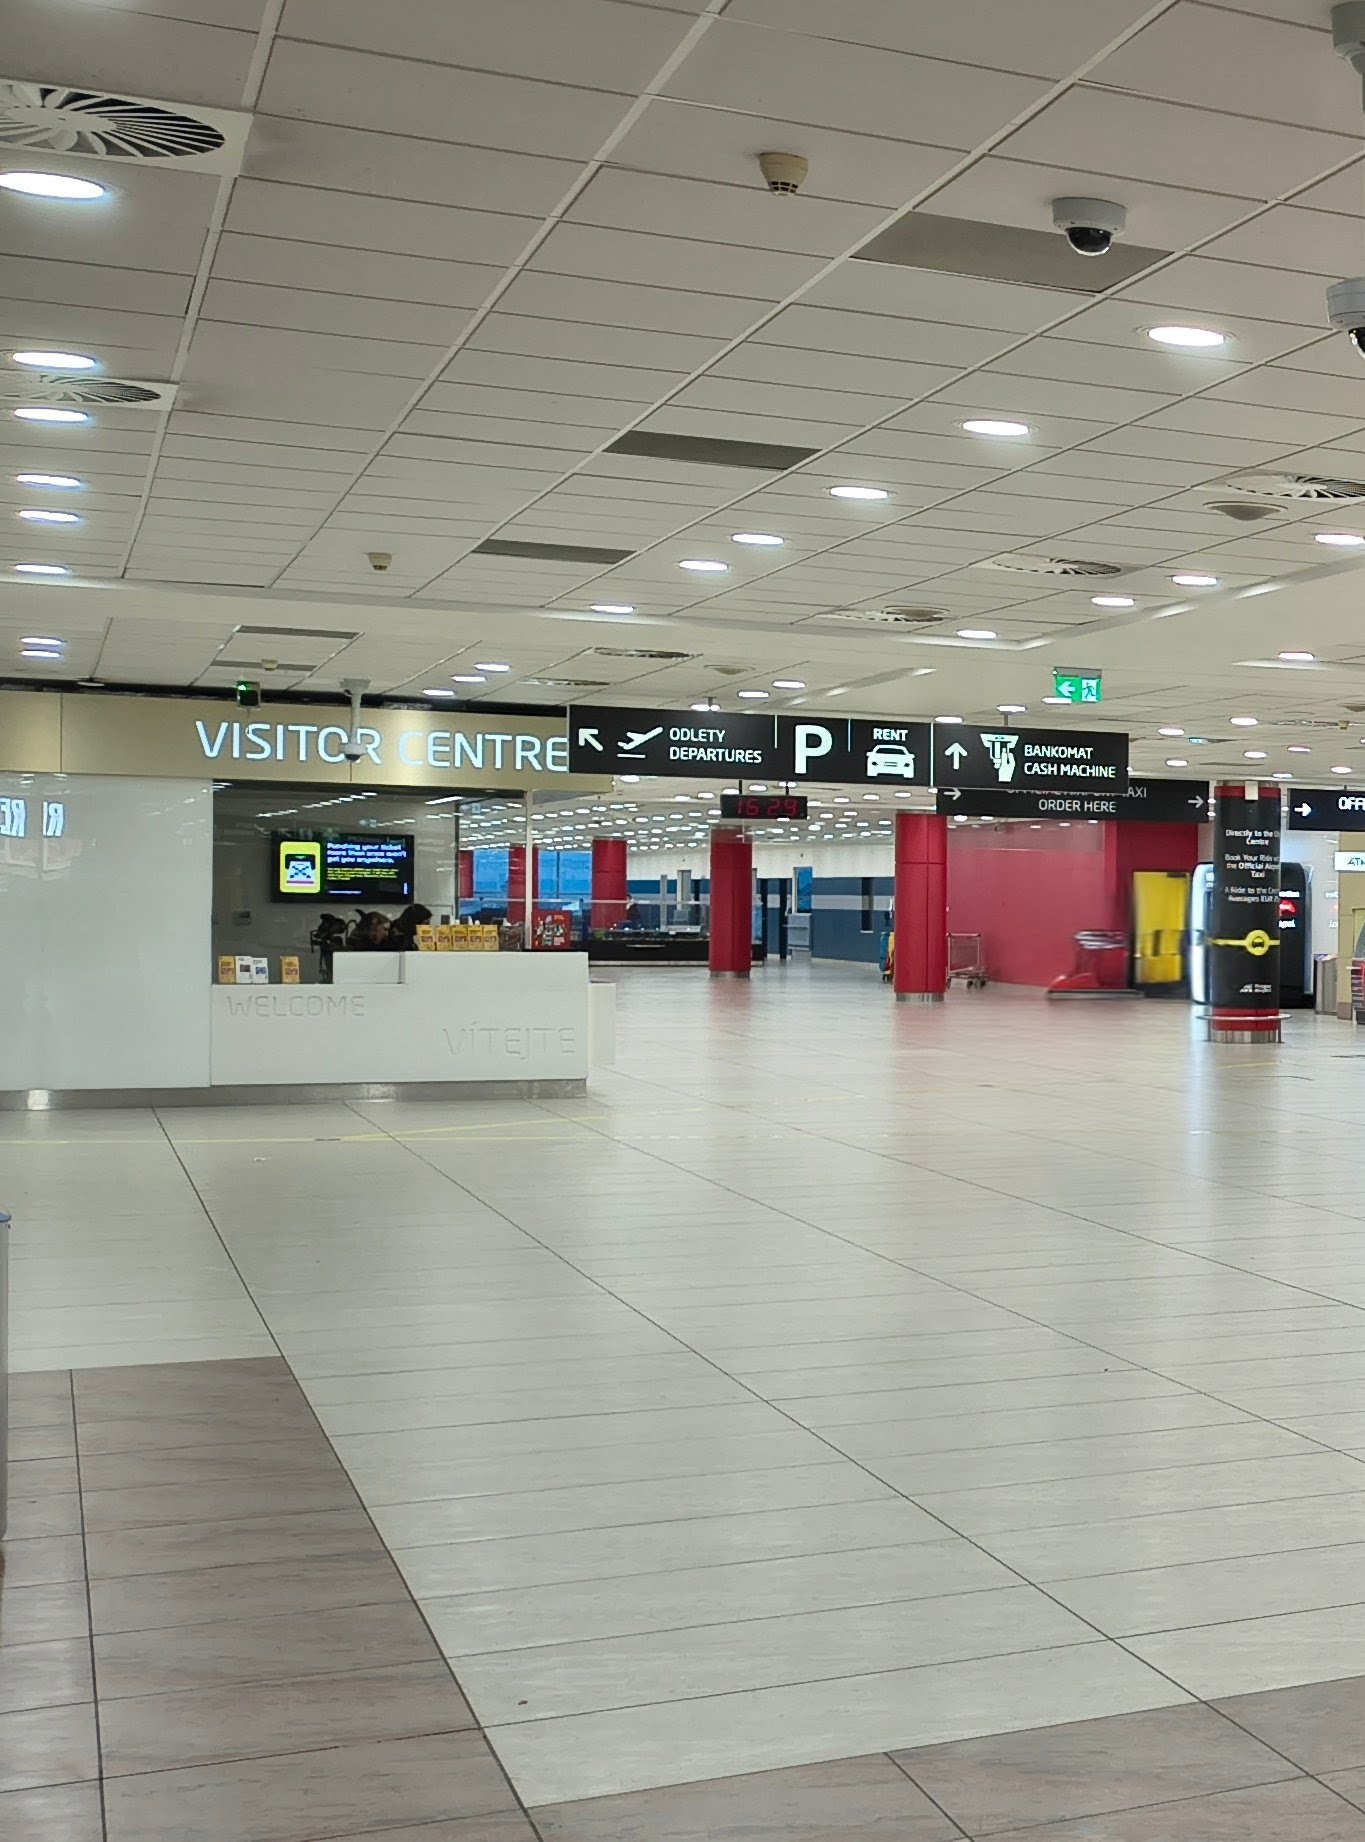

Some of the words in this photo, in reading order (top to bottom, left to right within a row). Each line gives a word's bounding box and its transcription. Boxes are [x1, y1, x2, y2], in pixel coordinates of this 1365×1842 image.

[669, 727, 726, 743] ODLETY
[873, 727, 909, 742] RENT
[195, 720, 382, 764] VISITOR
[395, 730, 568, 772] CENTRE
[794, 724, 833, 774] P
[1024, 744, 1094, 760] BANKOMAT
[669, 746, 762, 764] DEPARTURES
[1024, 762, 1058, 776] CASH
[1060, 764, 1116, 779] MACHINE
[1123, 786, 1147, 798] AXI
[1038, 798, 1081, 812] ORDER
[1084, 800, 1117, 813] HERE
[226, 994, 366, 1018] WELCOME
[442, 1021, 576, 1060] VÍTEJTE
